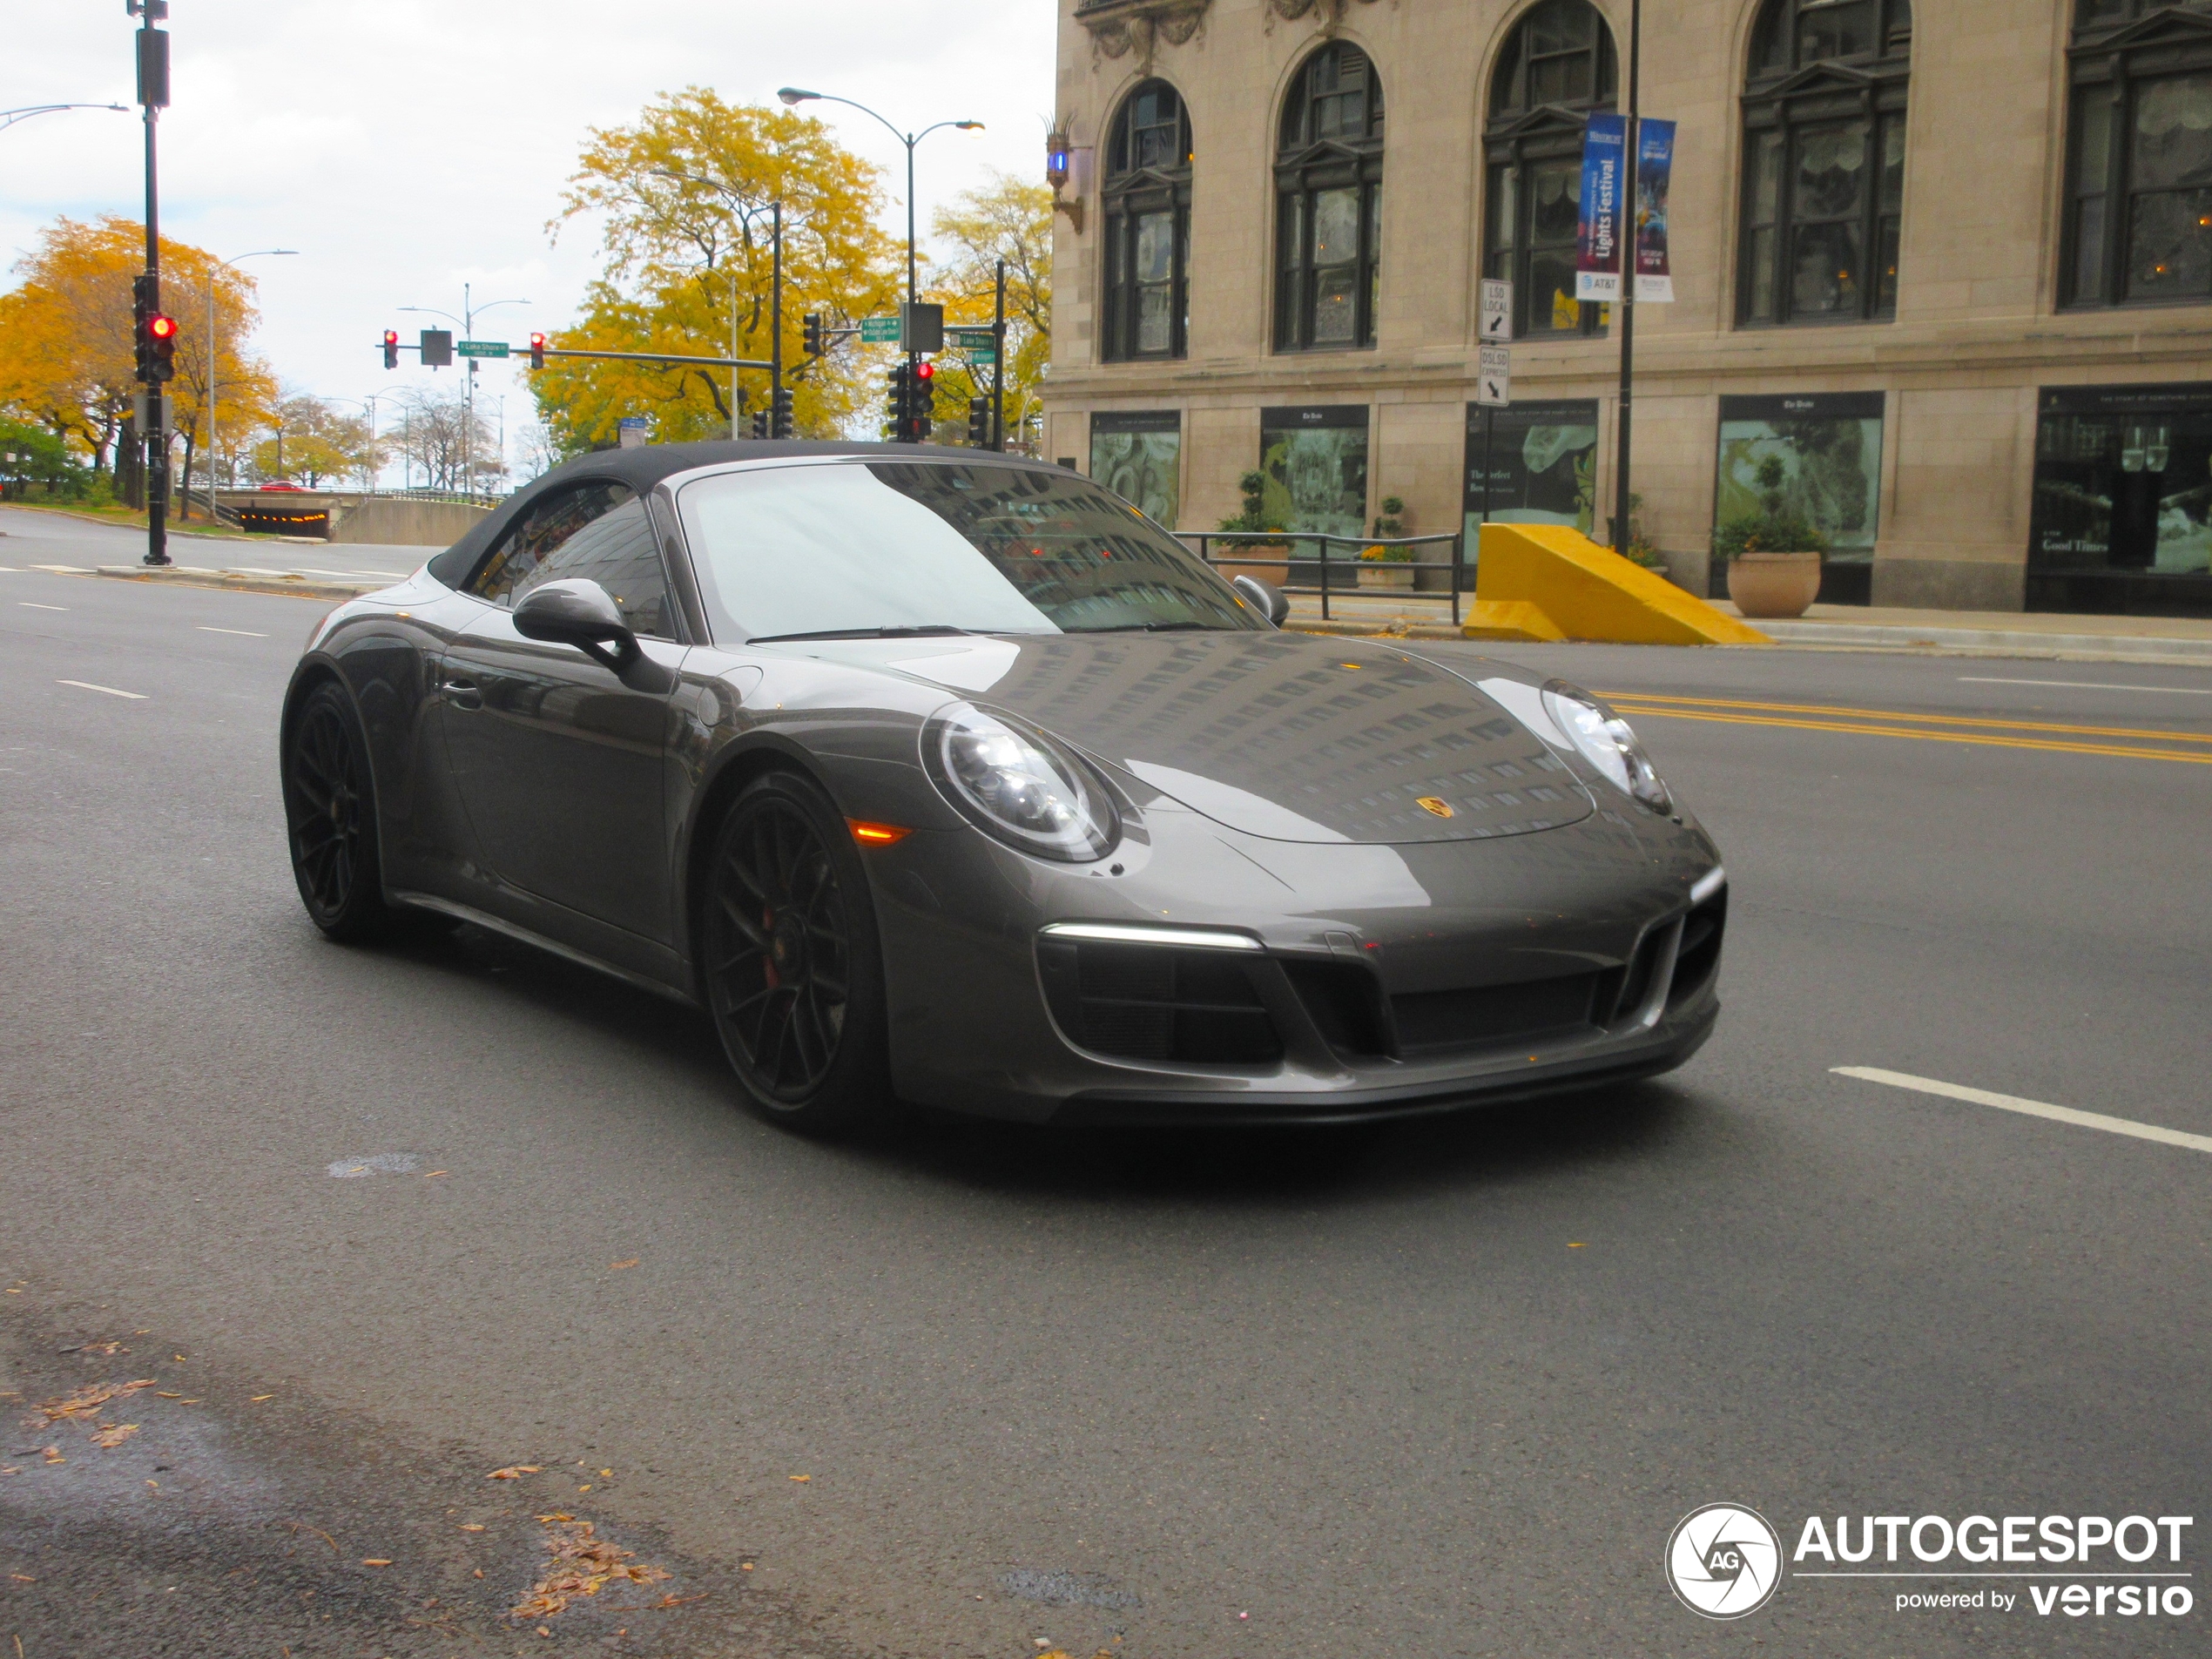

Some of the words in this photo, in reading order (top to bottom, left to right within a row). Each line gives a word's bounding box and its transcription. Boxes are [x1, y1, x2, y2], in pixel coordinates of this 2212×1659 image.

[1598, 159, 1615, 213] Festival
[1595, 216, 1614, 259] Lights
[1594, 278, 1616, 289] AT&T
[1489, 287, 1505, 298] LSD
[1484, 300, 1508, 313] LOCAL
[1482, 368, 1507, 377] EXPRESS
[1471, 469, 1485, 479] The
[1489, 470, 1511, 479] erfect
[2042, 538, 2073, 551] Good
[2075, 539, 2109, 552] Times
